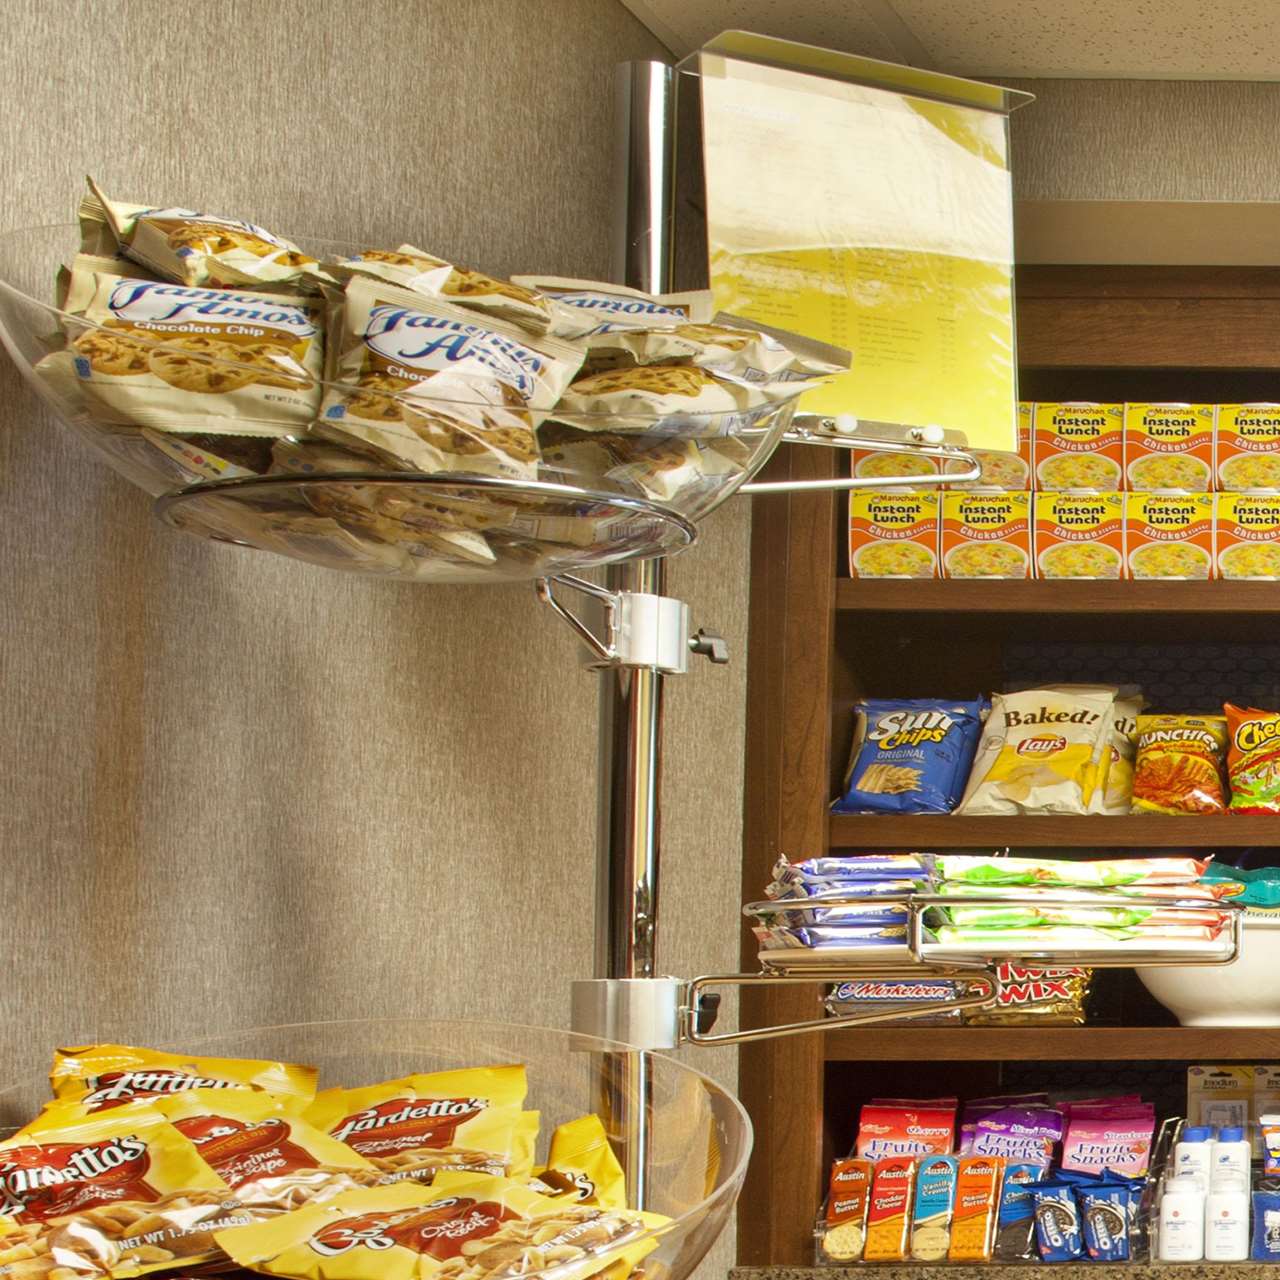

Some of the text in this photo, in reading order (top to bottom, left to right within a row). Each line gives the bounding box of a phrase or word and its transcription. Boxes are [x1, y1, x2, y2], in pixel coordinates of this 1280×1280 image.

[134, 321, 265, 337] Chocolate Chip
[1052, 416, 1106, 426] Instant
[1143, 417, 1196, 428] Instant
[1058, 426, 1100, 435] Lunch
[1149, 427, 1190, 436] Lunch
[1052, 437, 1098, 451] Chicken
[1144, 438, 1187, 452] Chicken
[1235, 437, 1278, 452] Chicken
[867, 503, 921, 514] Instant
[959, 504, 1012, 515] Instant
[1053, 505, 1106, 515] Instant
[1143, 505, 1196, 516] Instant
[873, 513, 916, 524] Lunch
[965, 513, 1006, 524] Lunch
[1058, 515, 1100, 524] Lunch
[1149, 515, 1190, 525] Lunch
[1239, 515, 1280, 525] Lunch
[868, 525, 913, 539] Chicken
[960, 525, 1003, 540] Chicken
[1054, 526, 1097, 540] Chicken
[1144, 526, 1187, 541] Chicken
[1233, 526, 1277, 541] Chicken
[1005, 707, 1098, 727] Baked!
[869, 712, 953, 740] Sun
[879, 729, 945, 749] Chips
[1023, 737, 1067, 752] Lay's
[877, 749, 925, 760] ORIGINAL
[858, 984, 951, 998] Musketeers
[330, 1098, 490, 1141] Gardetto's
[985, 1134, 1044, 1149] Fruity
[978, 1145, 1043, 1158] Snacks
[1071, 1154, 1137, 1164] Snacks
[835, 1172, 865, 1181] Austin
[878, 1170, 908, 1179] Austin
[923, 1167, 953, 1176] Austin
[963, 1167, 993, 1176] Austin
[1005, 1175, 1035, 1184] Austin
[118, 1231, 165, 1250] NET WT
